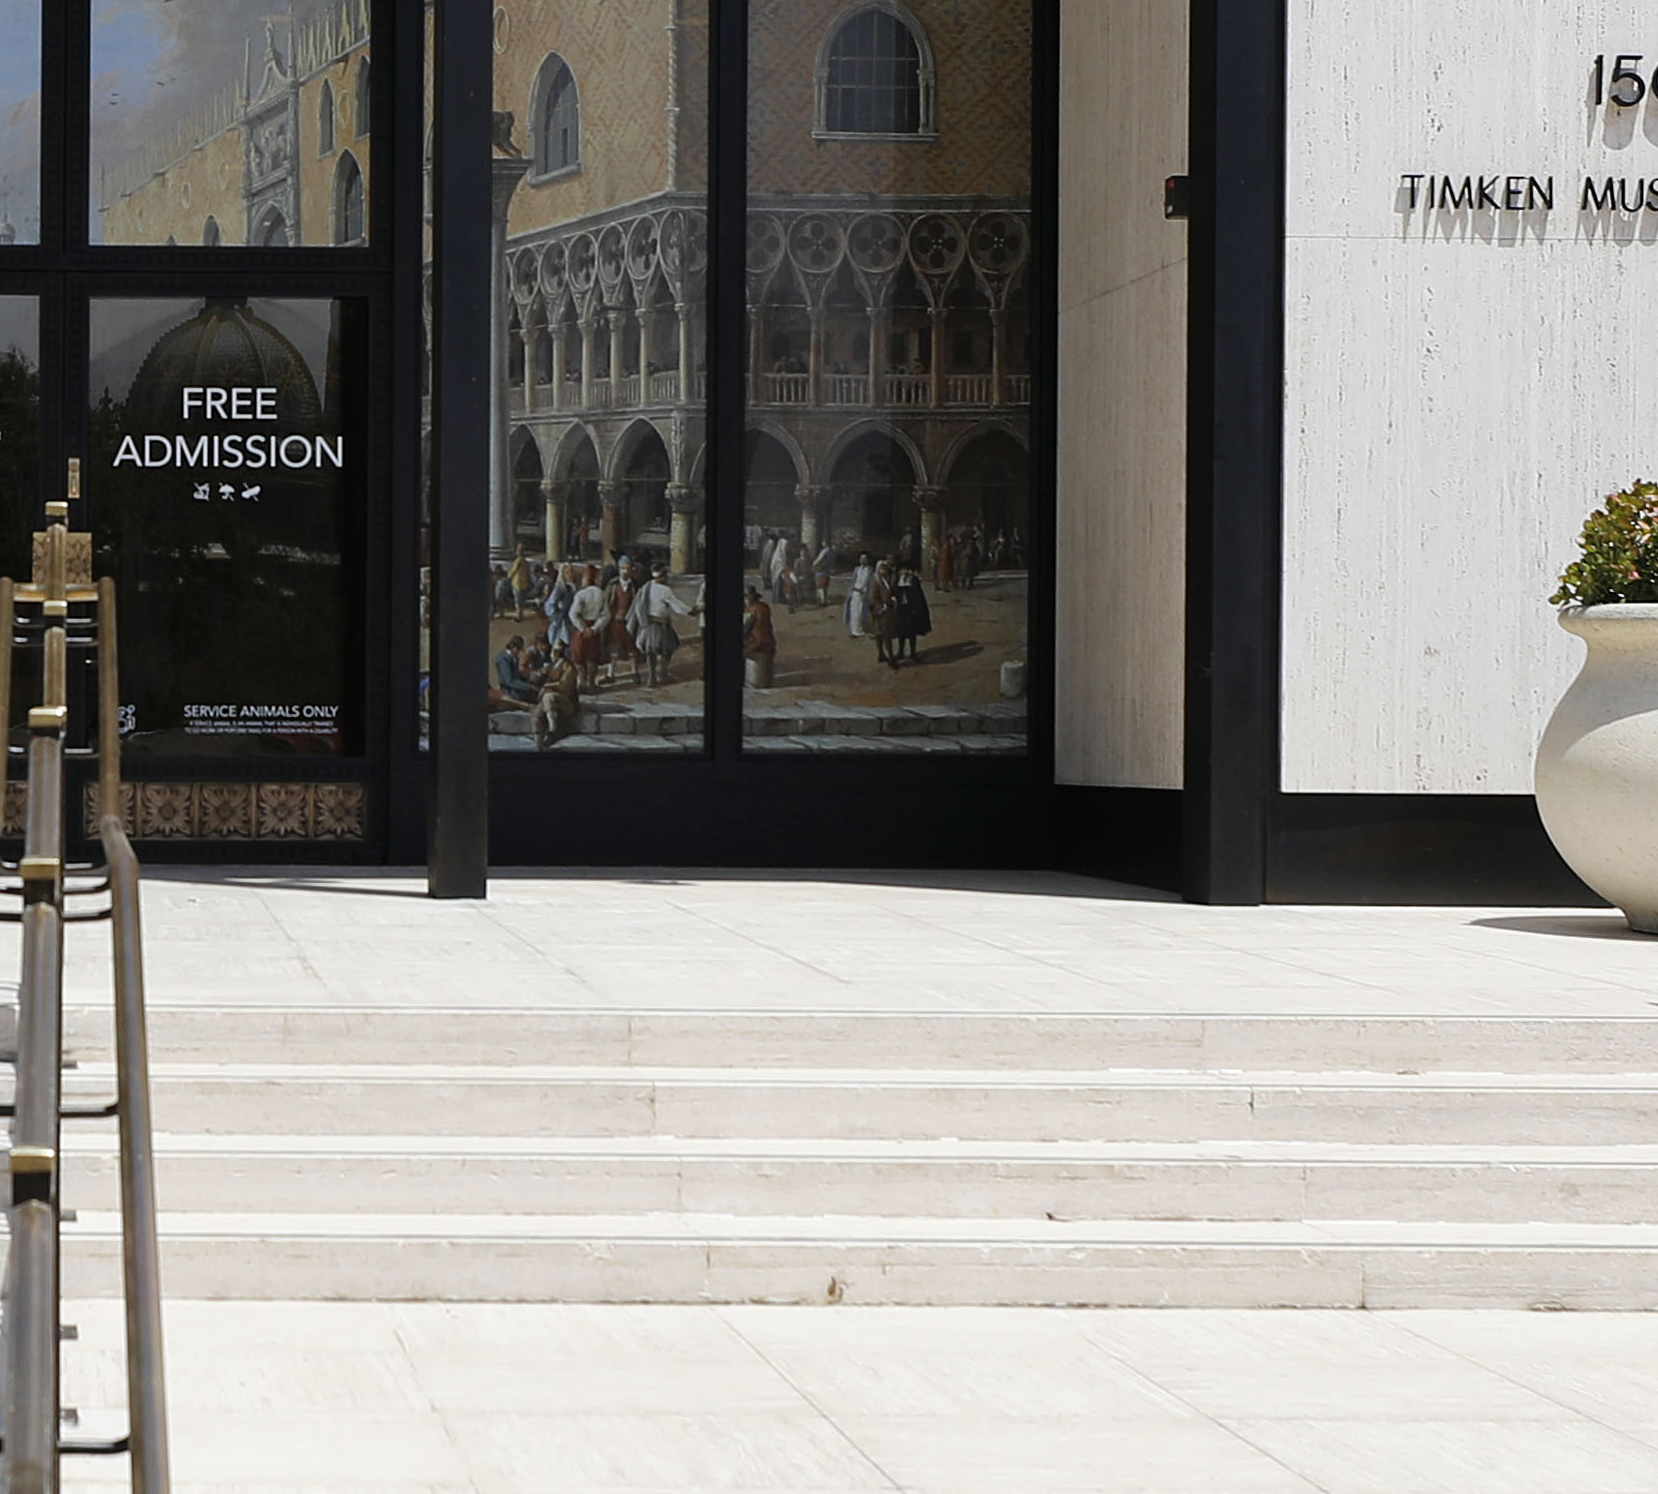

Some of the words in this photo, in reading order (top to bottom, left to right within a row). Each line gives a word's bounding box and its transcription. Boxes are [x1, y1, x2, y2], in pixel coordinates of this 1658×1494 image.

[1401, 175, 1553, 210] TIMKEN
[183, 387, 277, 419] FREE
[113, 435, 343, 468] ADMISSION
[184, 706, 236, 717] SERVICE
[240, 706, 299, 717] ANIMALS
[303, 706, 338, 717] ONLY
